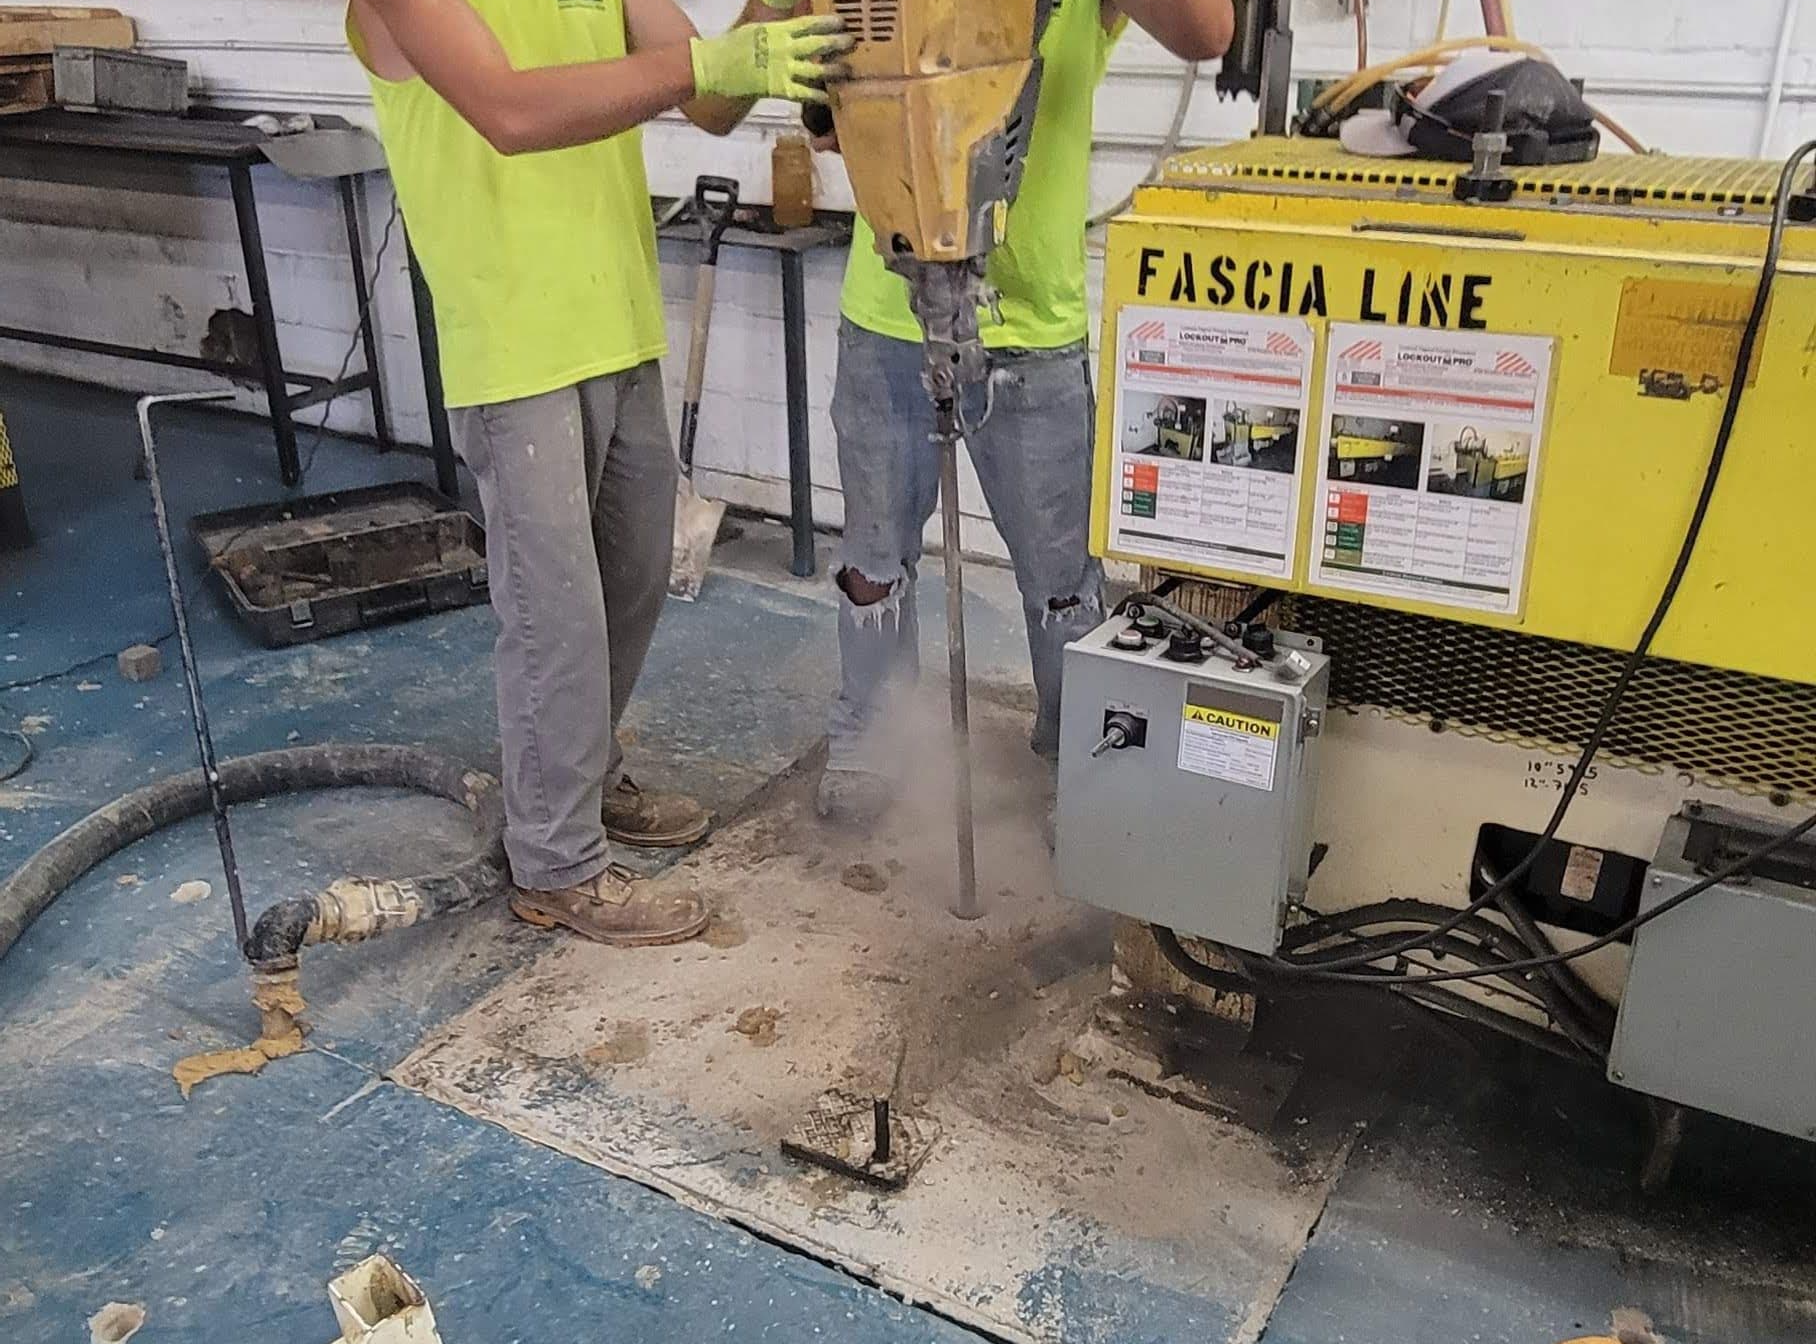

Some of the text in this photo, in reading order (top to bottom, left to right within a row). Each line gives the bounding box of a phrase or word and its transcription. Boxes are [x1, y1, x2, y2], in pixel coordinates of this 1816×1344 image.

[1138, 248, 1492, 329] FASCIA LINE
[1179, 332, 1219, 344] LOCKOUT
[1397, 352, 1473, 367] LOCKOUT PRO
[1206, 713, 1271, 737] CAUTION
